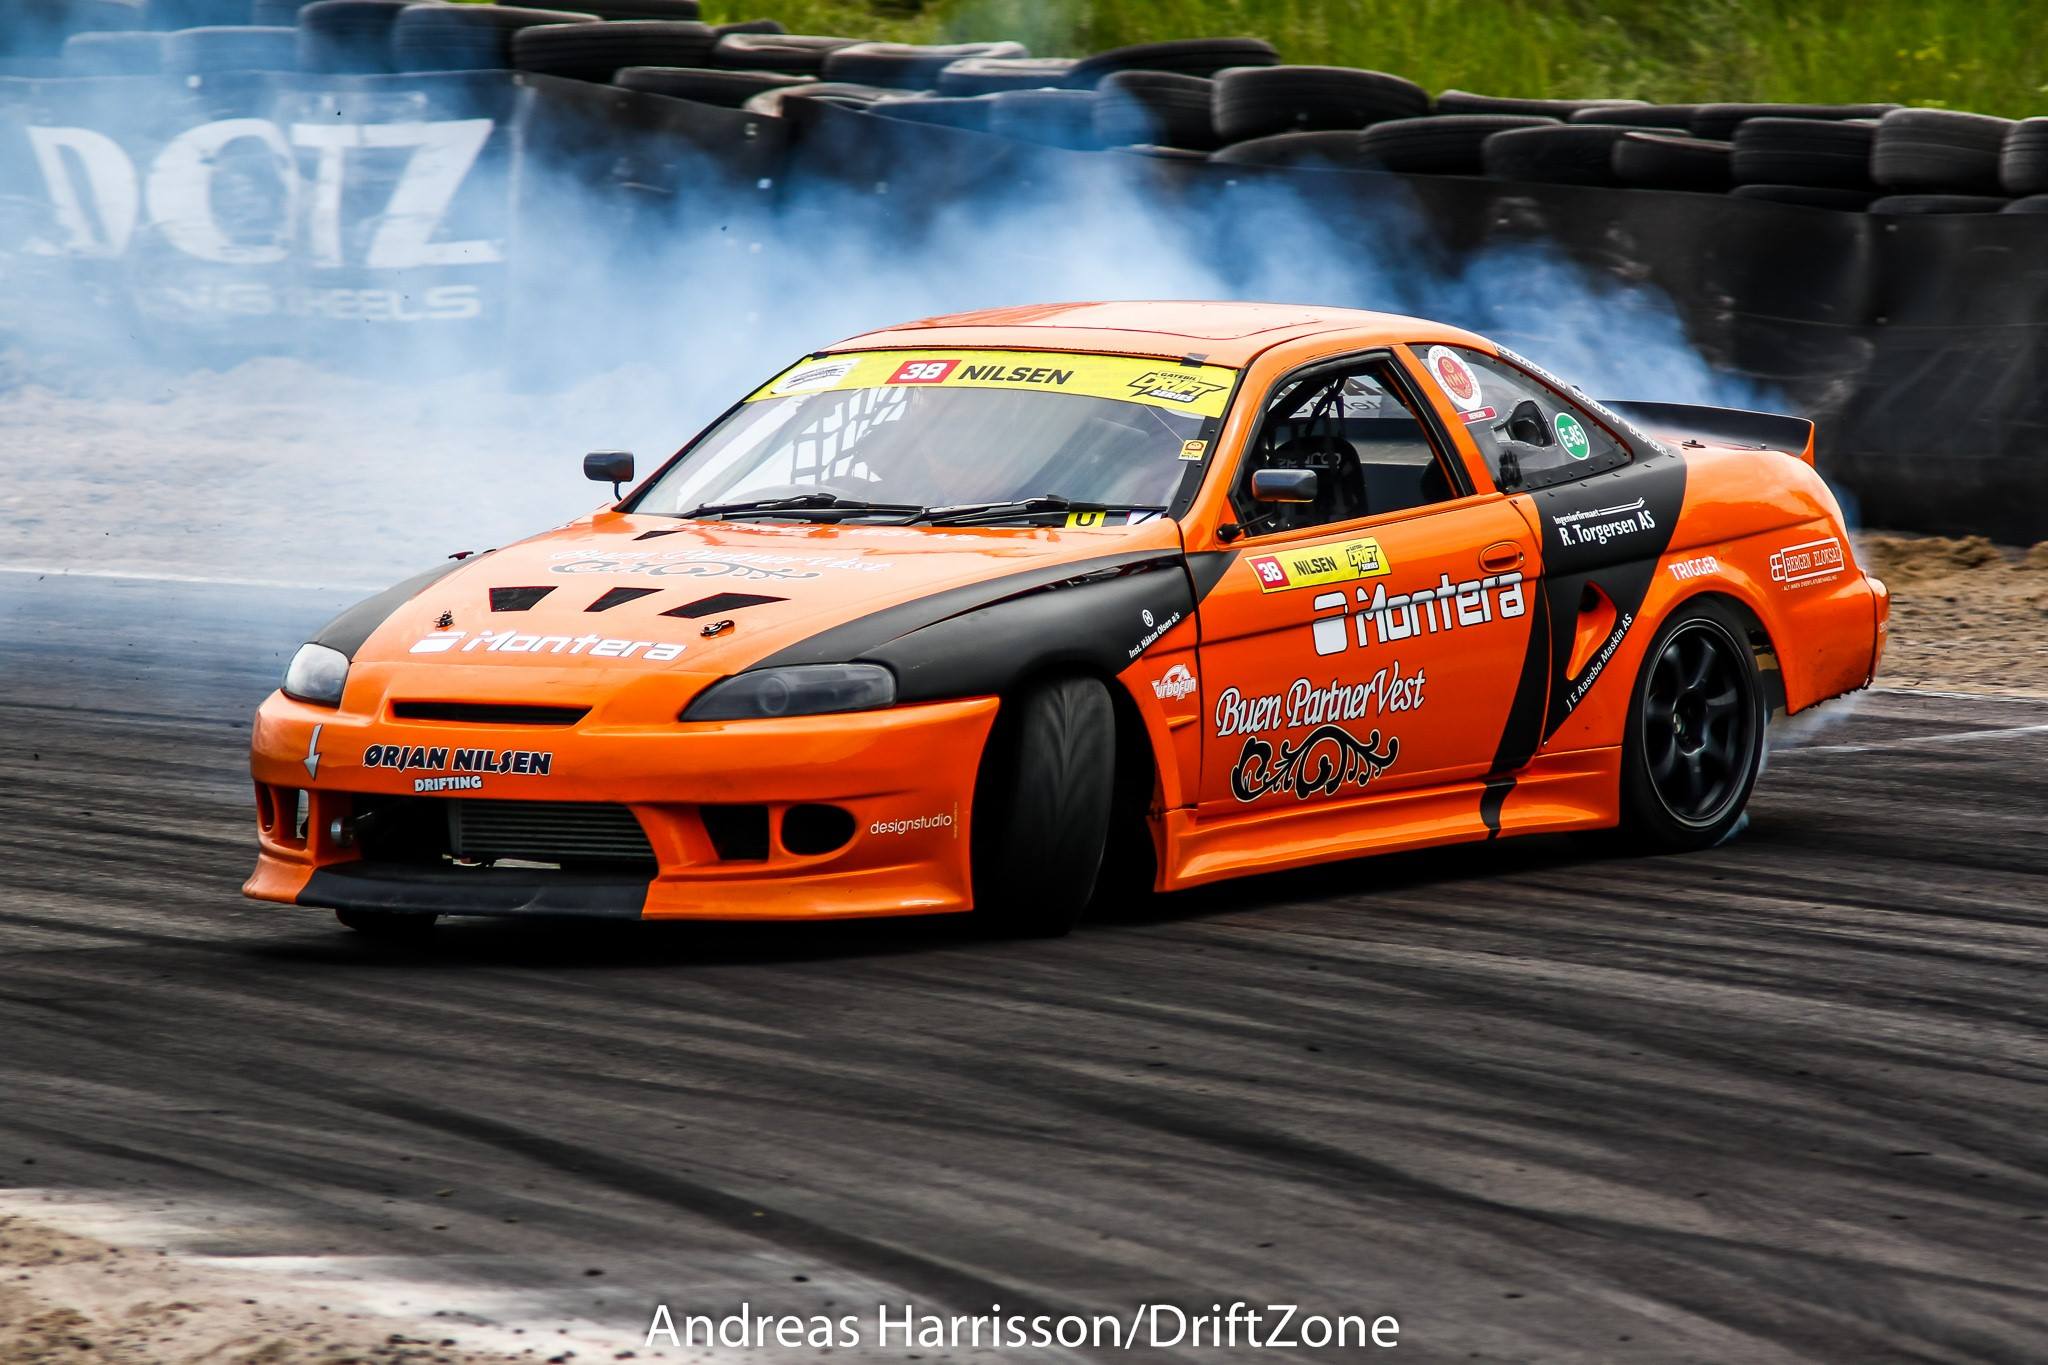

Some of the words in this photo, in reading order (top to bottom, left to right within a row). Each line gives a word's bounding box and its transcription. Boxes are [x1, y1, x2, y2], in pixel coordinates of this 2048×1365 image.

[24, 118, 505, 268] DOTZ
[899, 362, 948, 380] 38
[958, 365, 1074, 385] NILSEN
[1127, 373, 1227, 397] DRIFT
[1160, 372, 1197, 381] GATEBIL
[1149, 389, 1196, 403] SERIES
[1559, 424, 1585, 448] E-85
[1558, 527, 1576, 546] R.
[1572, 518, 1638, 545] Torgersen
[1637, 509, 1656, 530] AS
[1257, 561, 1283, 582] 38
[1293, 556, 1338, 576] NILSEN
[1347, 546, 1378, 569] DRIFT
[1668, 555, 1720, 581] TRIGGER
[1785, 552, 1812, 573] BERGEN
[1356, 572, 1525, 647] Montera
[1157, 619, 1172, 636] Olsen
[461, 629, 687, 661] Montera
[1566, 699, 1572, 712] J
[1570, 692, 1578, 703] E
[1600, 628, 1625, 663] Maskin
[1622, 613, 1633, 630] AS
[1215, 687, 1283, 737] Buen
[363, 744, 449, 772] ØRJAN
[451, 747, 553, 776] NILSEN
[414, 775, 483, 792] DRIFTING
[870, 813, 952, 835] designstudio
